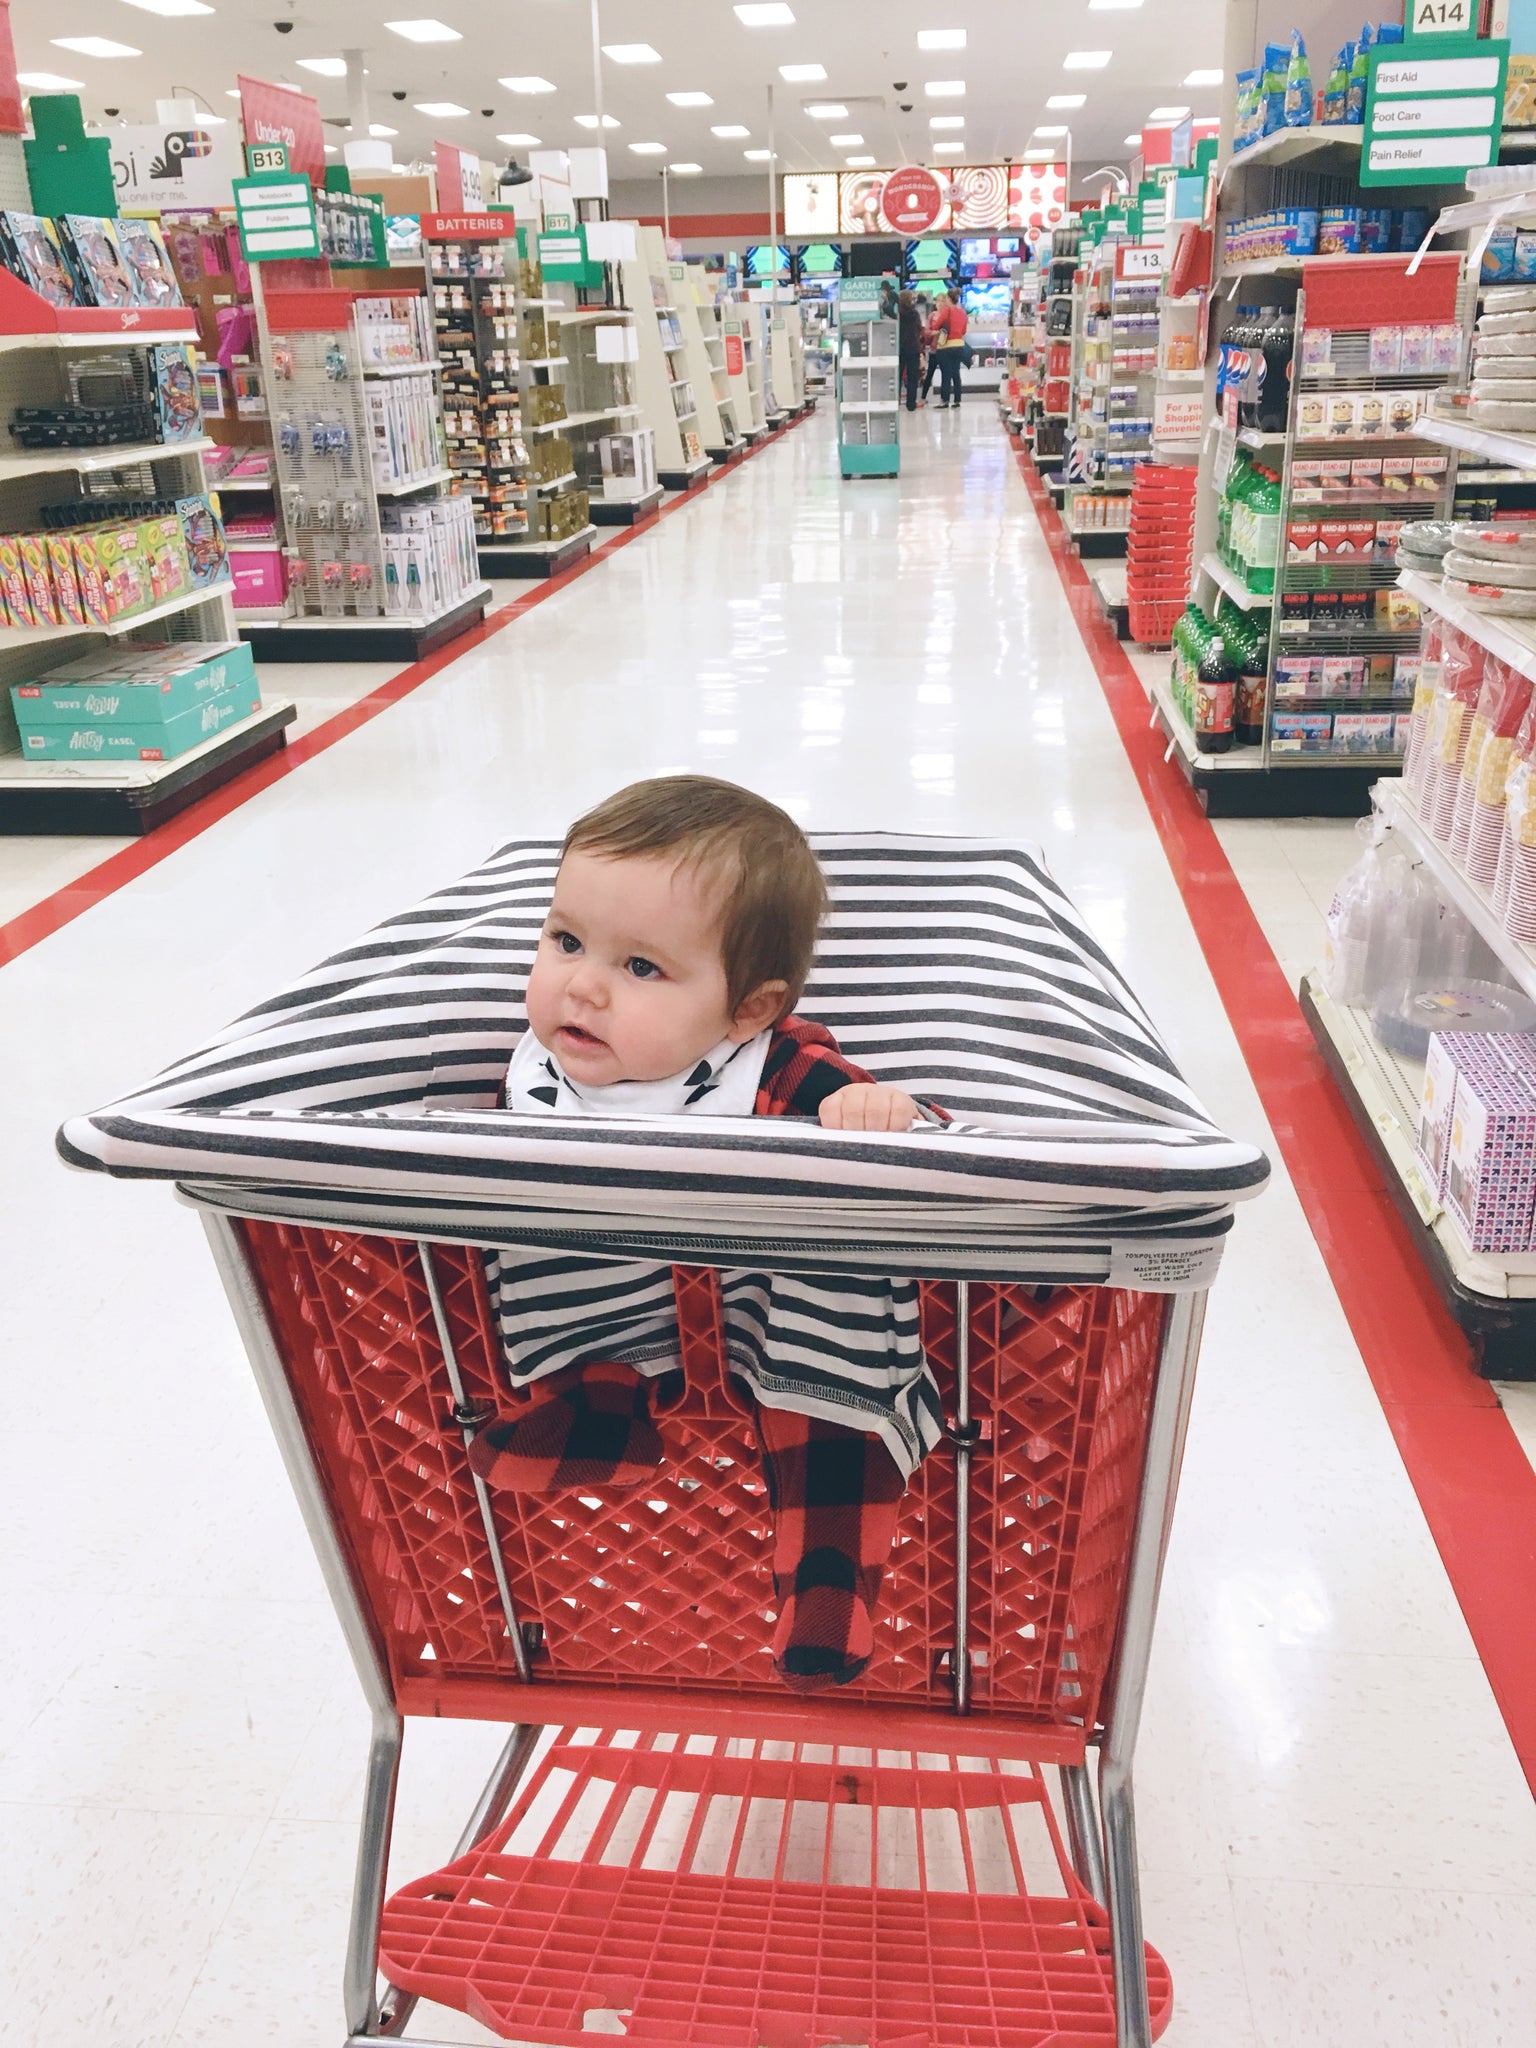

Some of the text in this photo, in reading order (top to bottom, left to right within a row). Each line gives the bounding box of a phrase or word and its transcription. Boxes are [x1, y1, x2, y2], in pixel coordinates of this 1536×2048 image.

[1418, 2, 1465, 24] A14
[1376, 70, 1419, 84] First Aid
[1372, 110, 1422, 122] Foot Care
[254, 119, 281, 143] Under
[253, 152, 284, 168] B13
[1370, 148, 1423, 161] Pain Relief
[461, 168, 482, 199] 9.99
[151, 192, 166, 201] for
[436, 218, 504, 231] BATTERIES
[549, 218, 568, 228] B17
[844, 281, 876, 290] GARTH
[842, 290, 878, 300] BROOKS
[1166, 403, 1183, 412] For
[108, 737, 136, 746] EASEL
